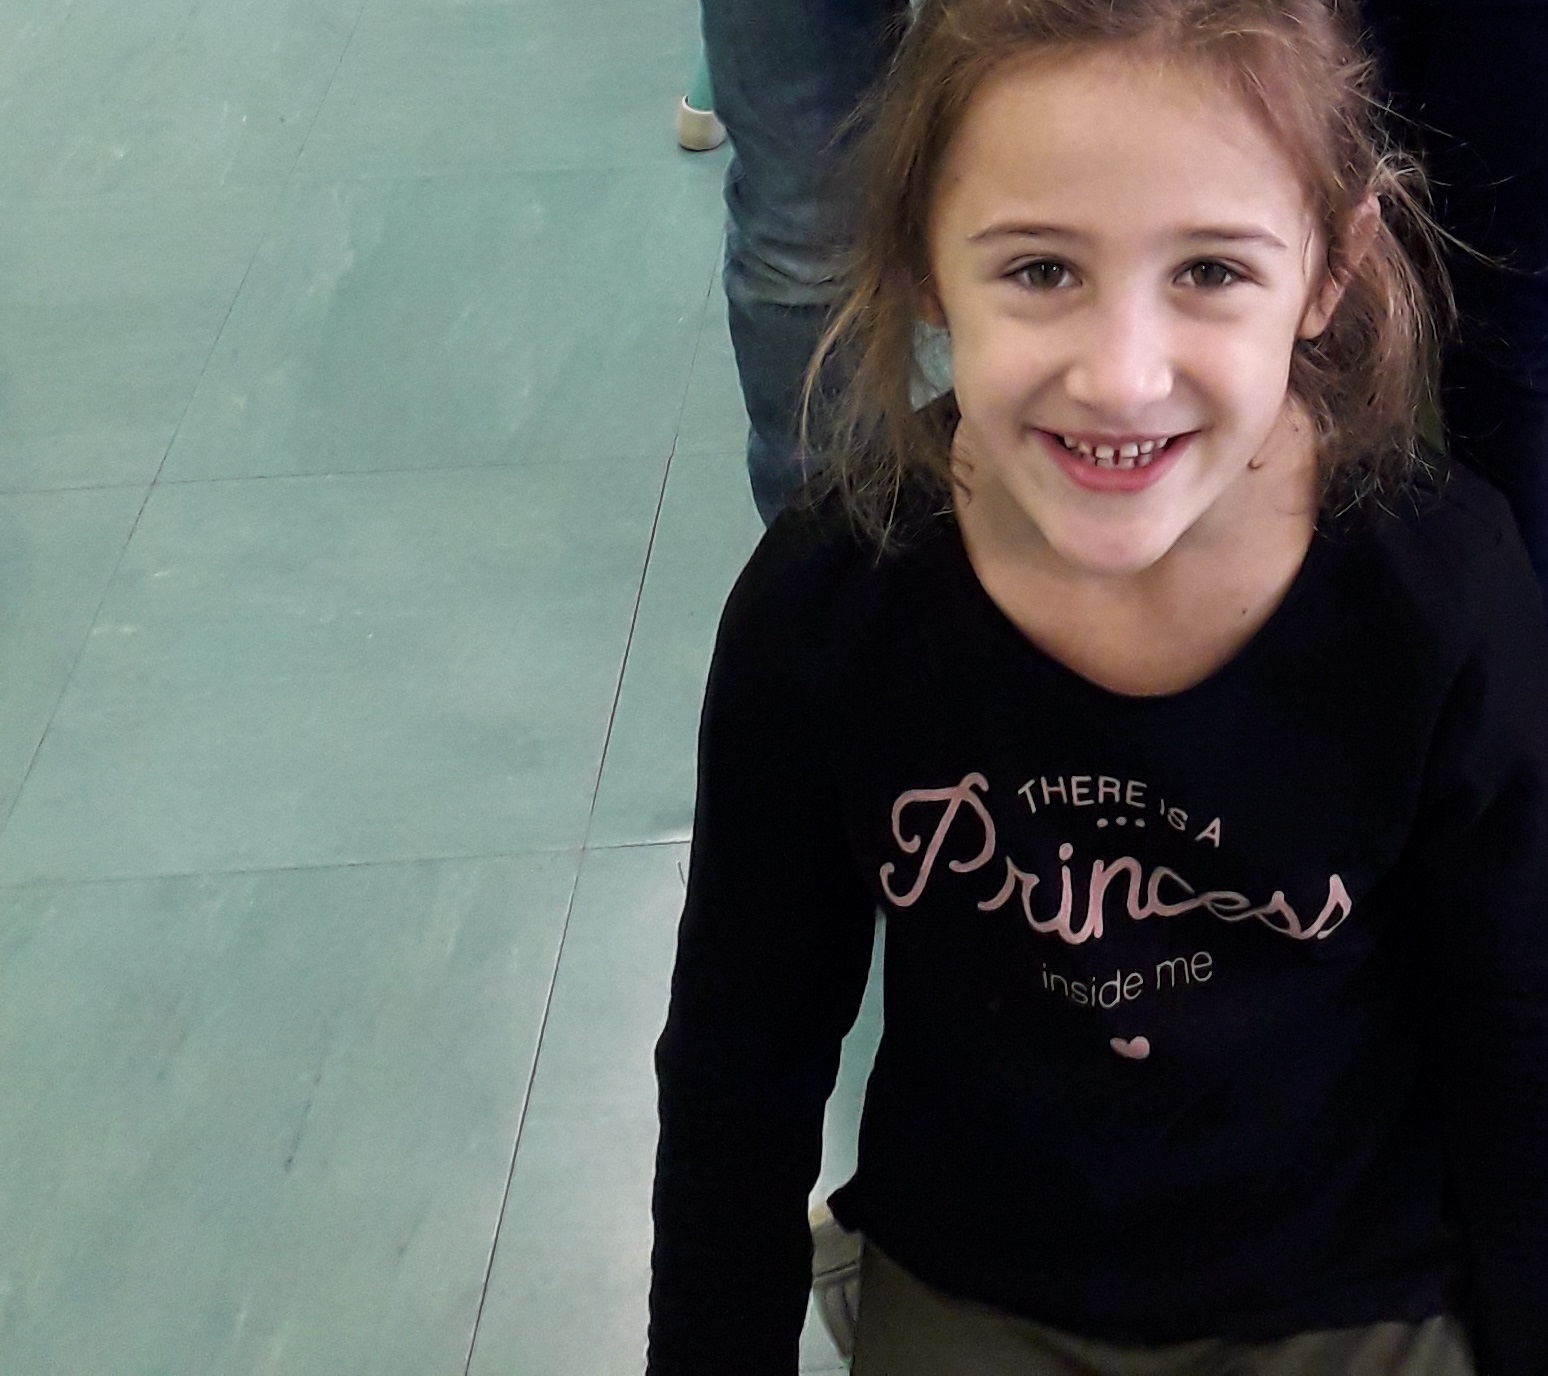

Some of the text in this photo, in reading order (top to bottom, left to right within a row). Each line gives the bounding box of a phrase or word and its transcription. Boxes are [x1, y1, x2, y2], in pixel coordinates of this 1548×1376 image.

[1017, 775, 1222, 848] THERE IS A
[880, 772, 1352, 945] Princess
[1042, 950, 1214, 1008] inside me
